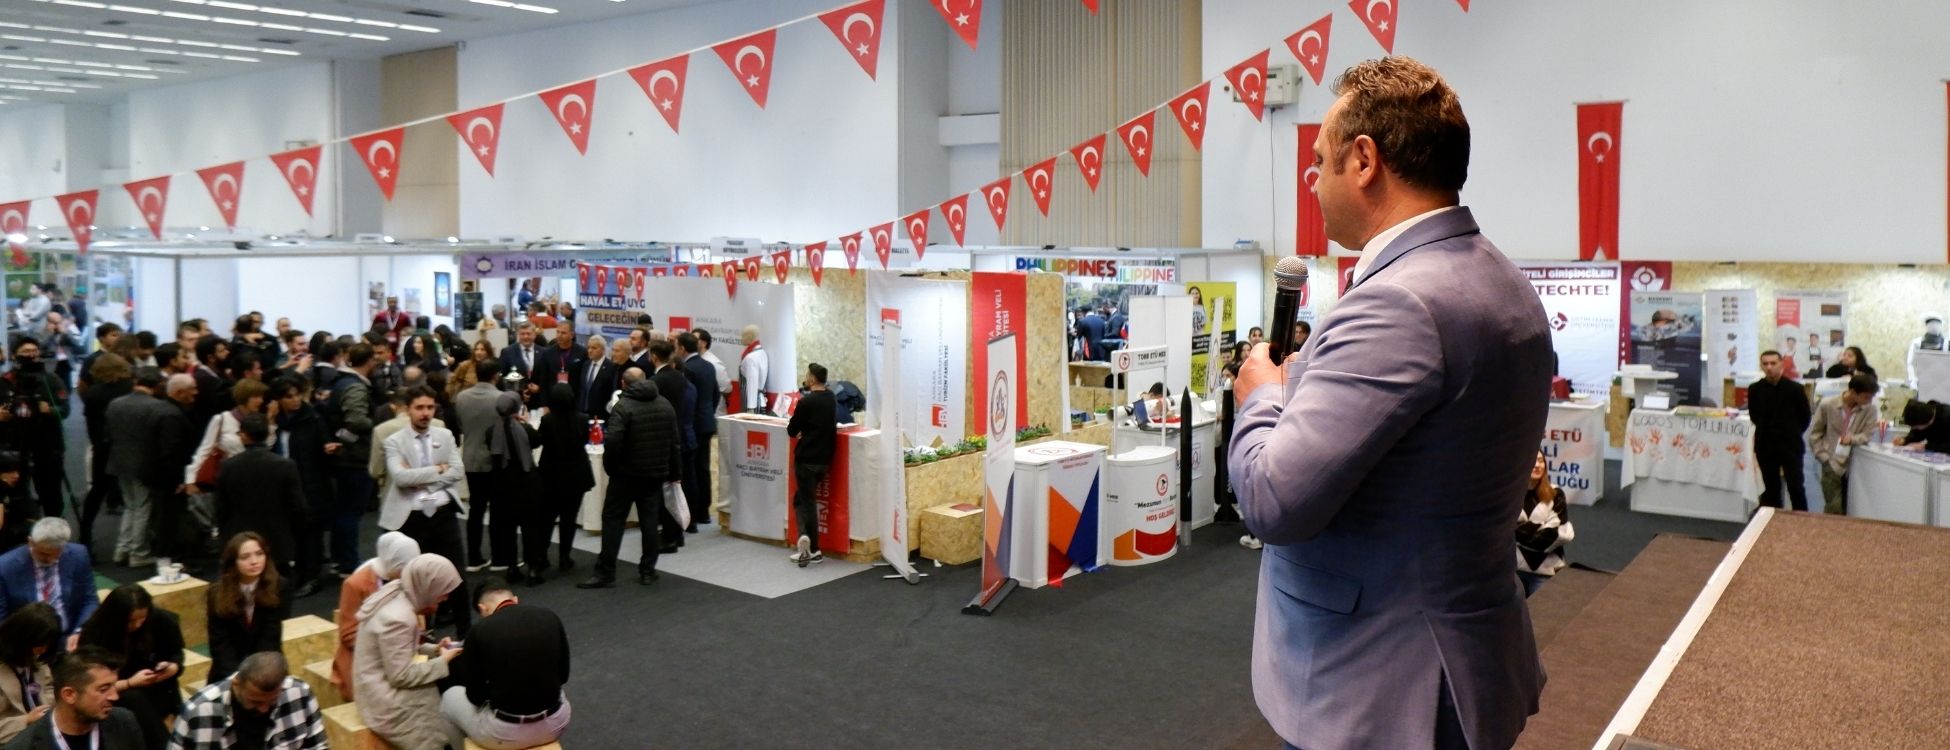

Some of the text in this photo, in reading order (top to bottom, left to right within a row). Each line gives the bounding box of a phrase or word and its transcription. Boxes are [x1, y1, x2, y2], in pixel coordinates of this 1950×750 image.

[504, 257, 531, 271] İRAN
[535, 256, 566, 270] İSLAM
[1016, 257, 1118, 278] PHILIPPINES
[1535, 284, 1609, 296] TECHTE!
[580, 294, 610, 308] HAYAL
[994, 289, 1002, 309] VELİ
[1550, 428, 1582, 442] ETÜ
